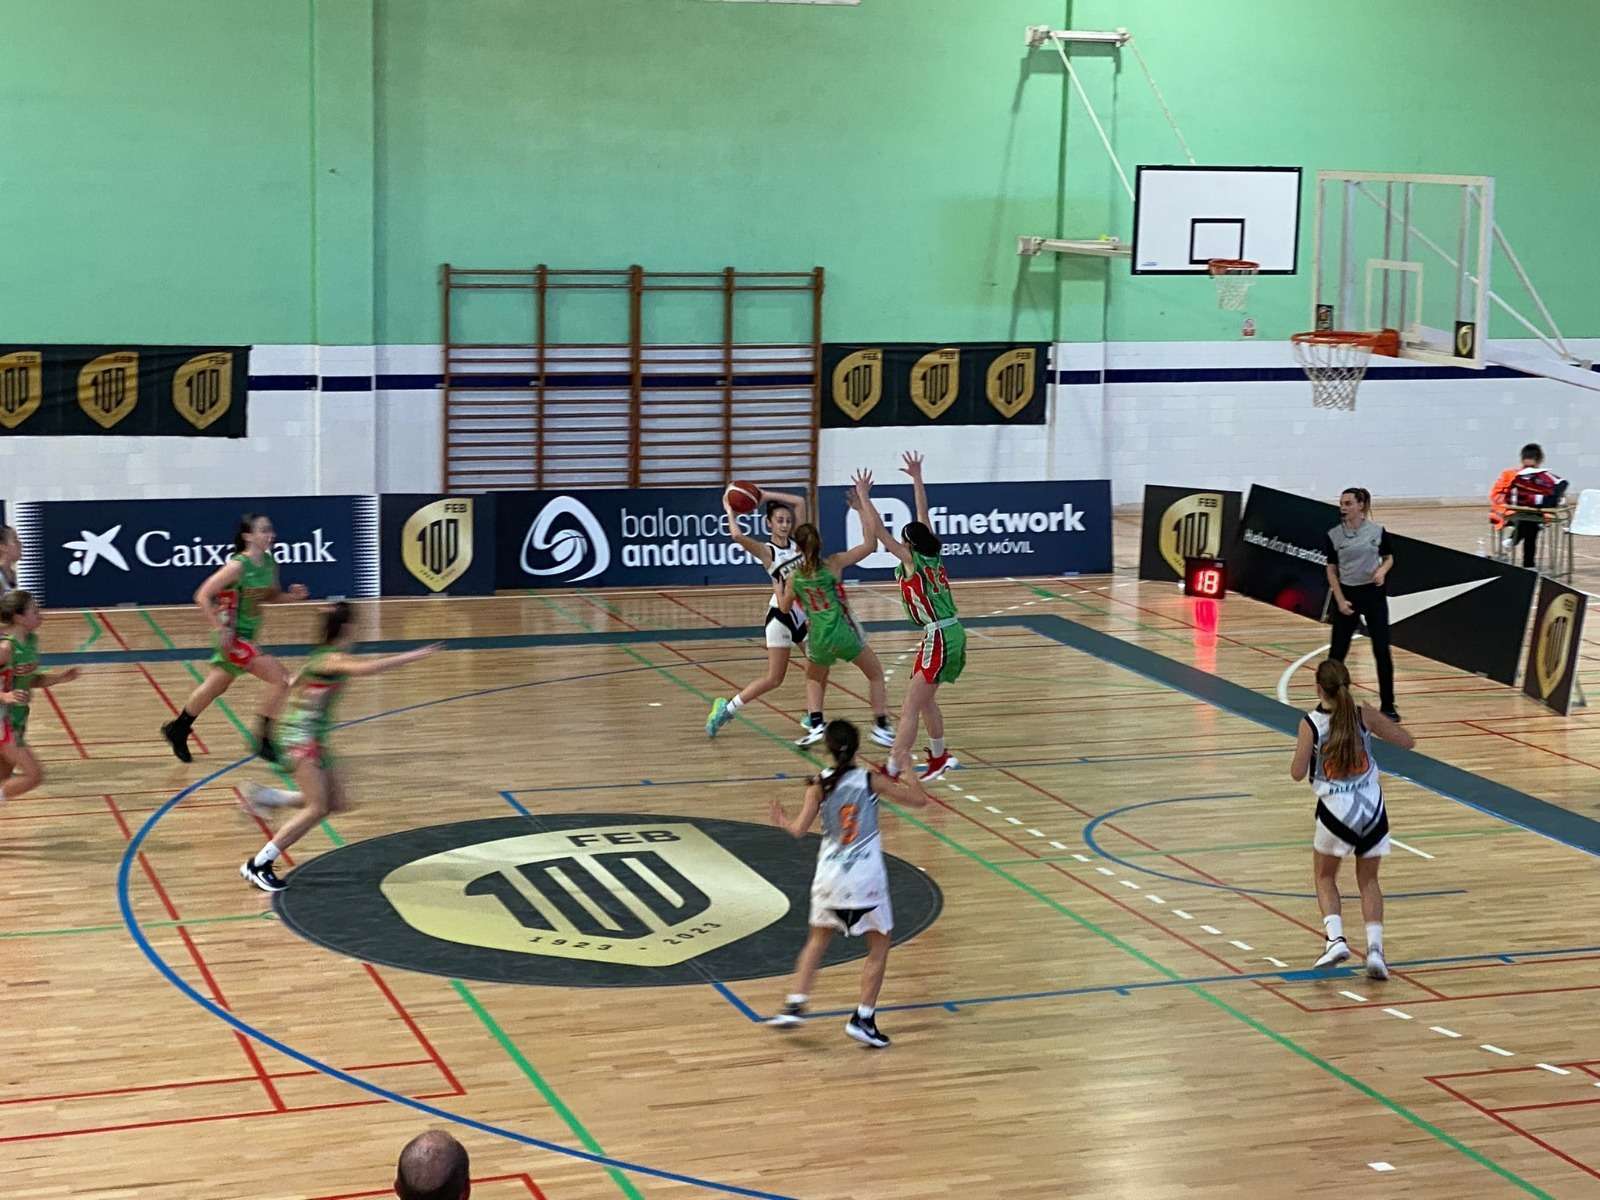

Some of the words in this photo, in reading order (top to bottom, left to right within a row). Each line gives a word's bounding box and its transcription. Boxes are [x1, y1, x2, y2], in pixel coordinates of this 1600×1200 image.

[444, 503, 467, 513] FEB
[928, 503, 1086, 535] finetwork
[135, 527, 337, 568] Caixaank
[940, 542, 972, 557] BRA
[974, 542, 985, 554] Y
[988, 538, 1034, 554] MÓVIL
[1196, 570, 1220, 594] 18
[566, 830, 682, 847] FEB
[465, 850, 711, 940] 100
[529, 936, 613, 951] 1923
[663, 922, 722, 945] 2023
